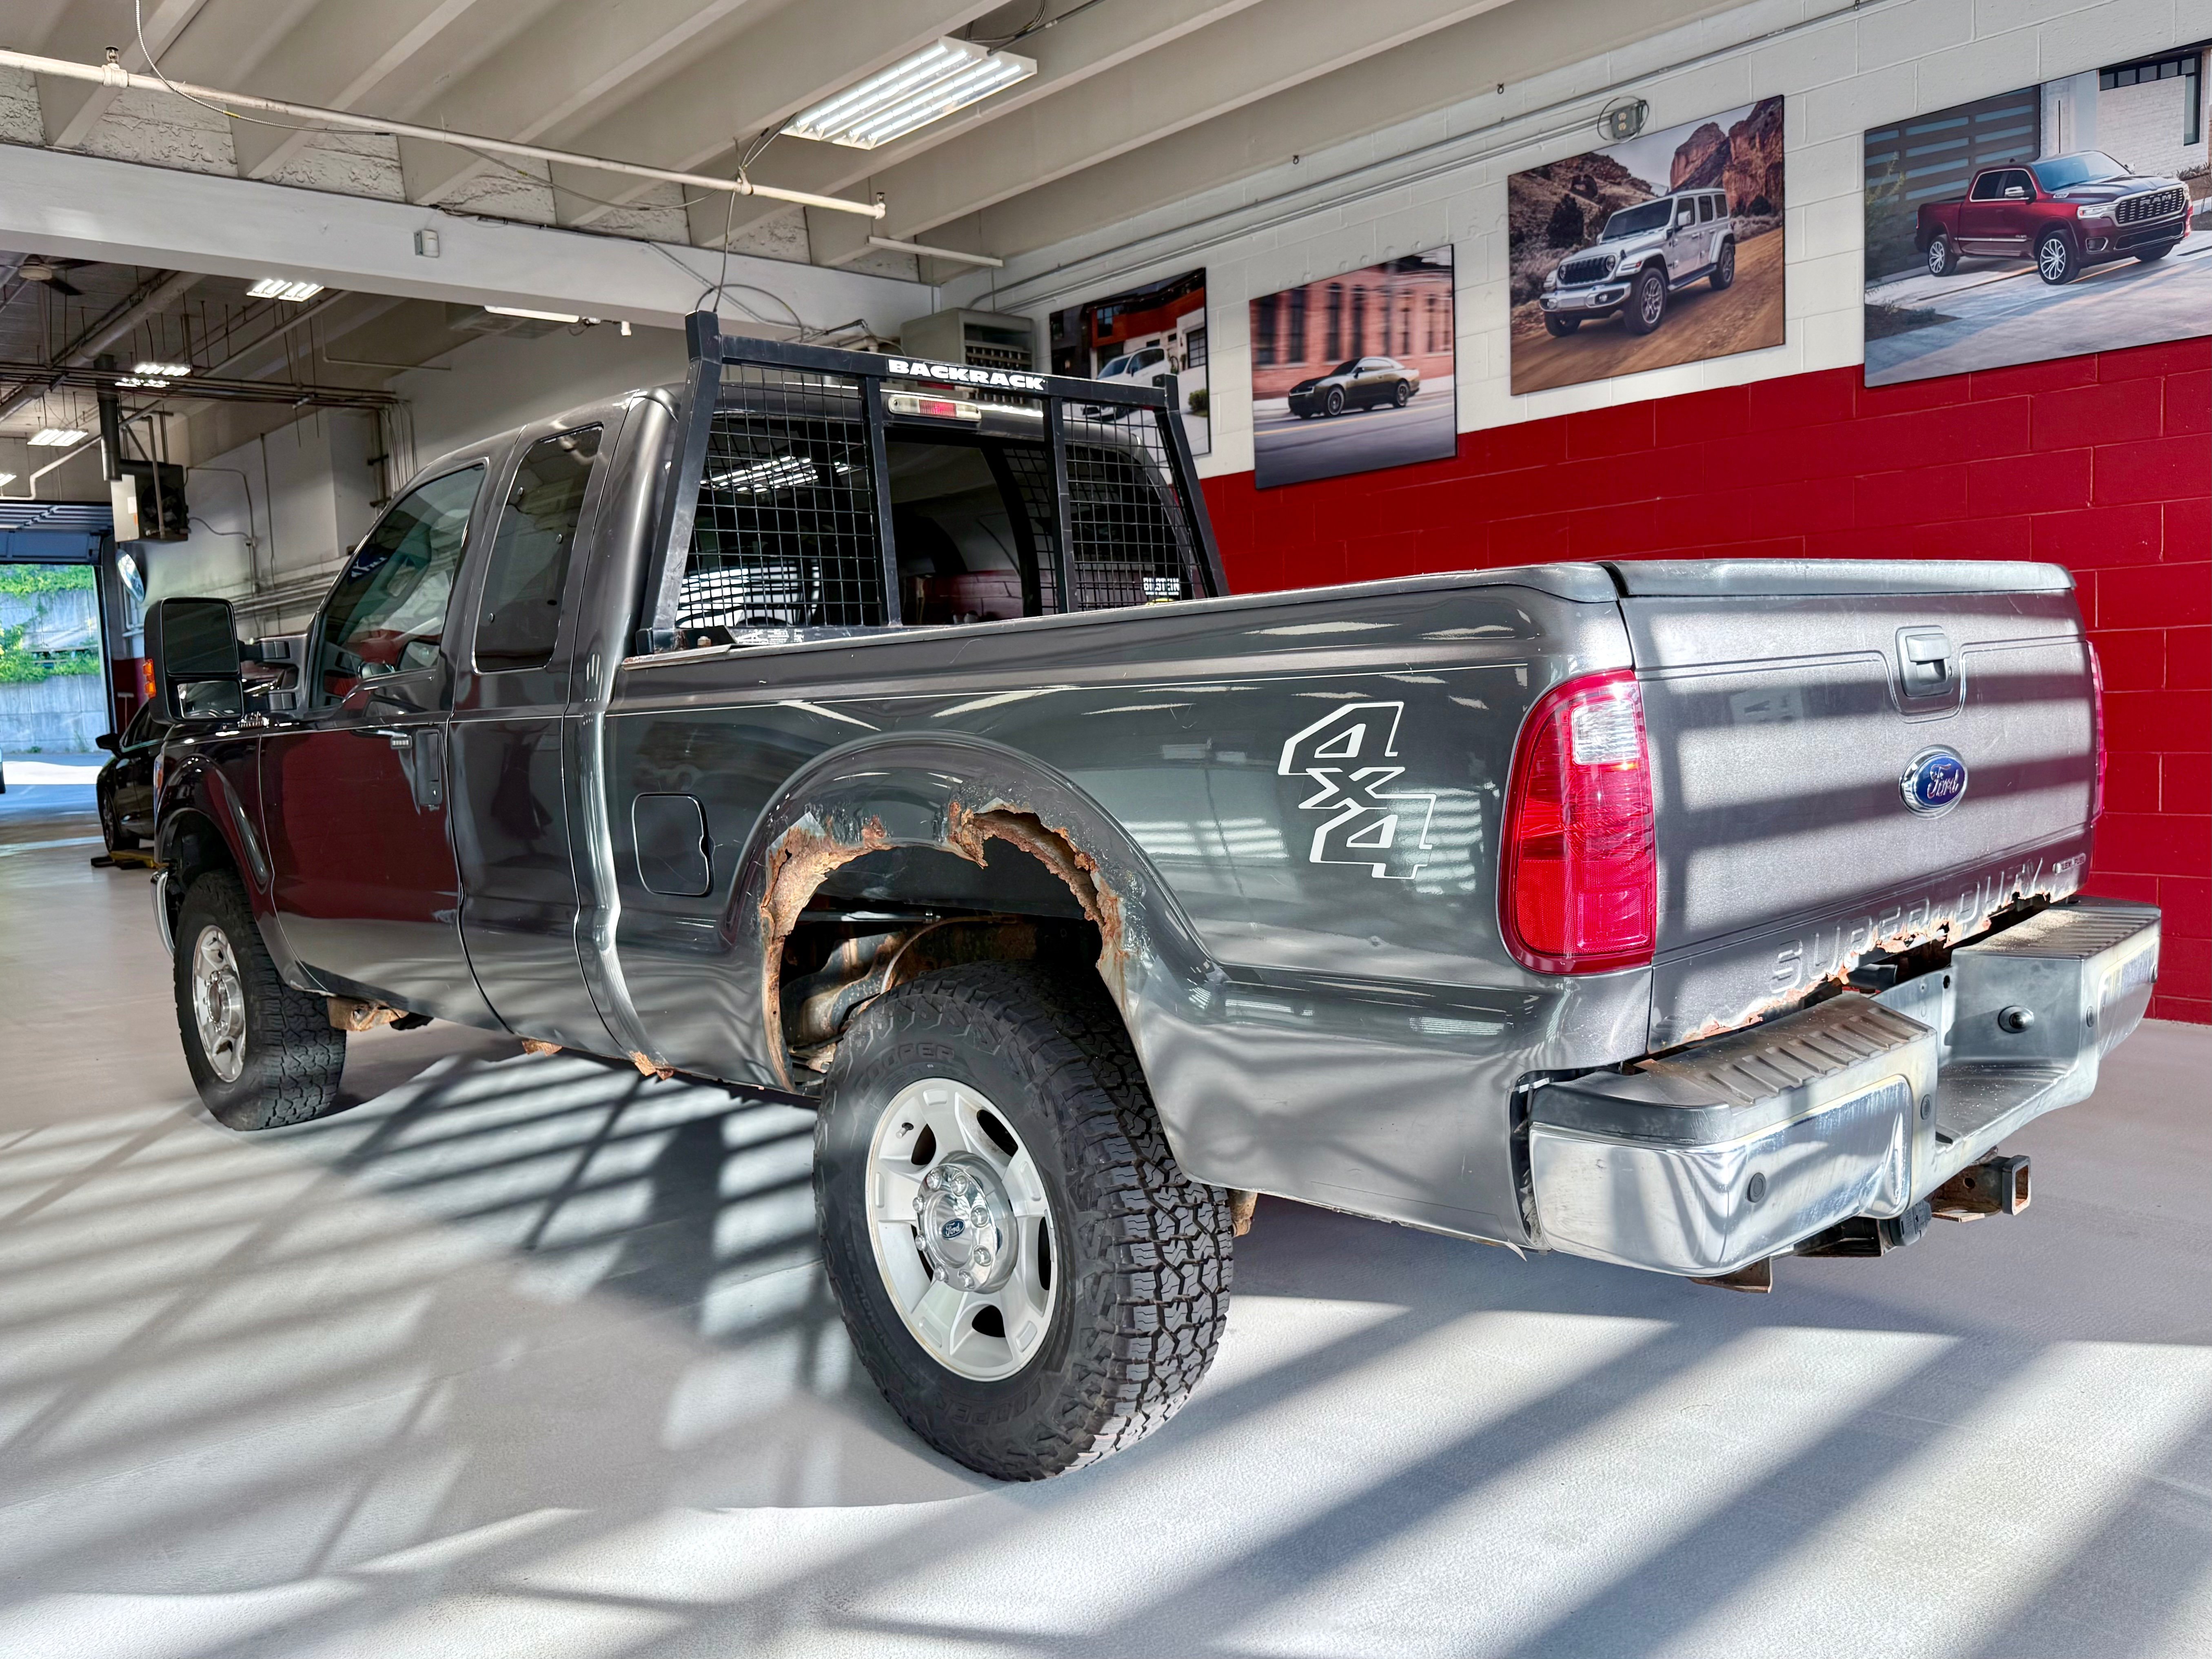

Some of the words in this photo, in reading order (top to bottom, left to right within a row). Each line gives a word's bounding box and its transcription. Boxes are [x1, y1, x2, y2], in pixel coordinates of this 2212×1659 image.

[2139, 194, 2172, 206] RAM
[888, 359, 1044, 390] BACKRACK
[1927, 763, 1959, 799] Ford
[945, 1222, 961, 1237] Ford
